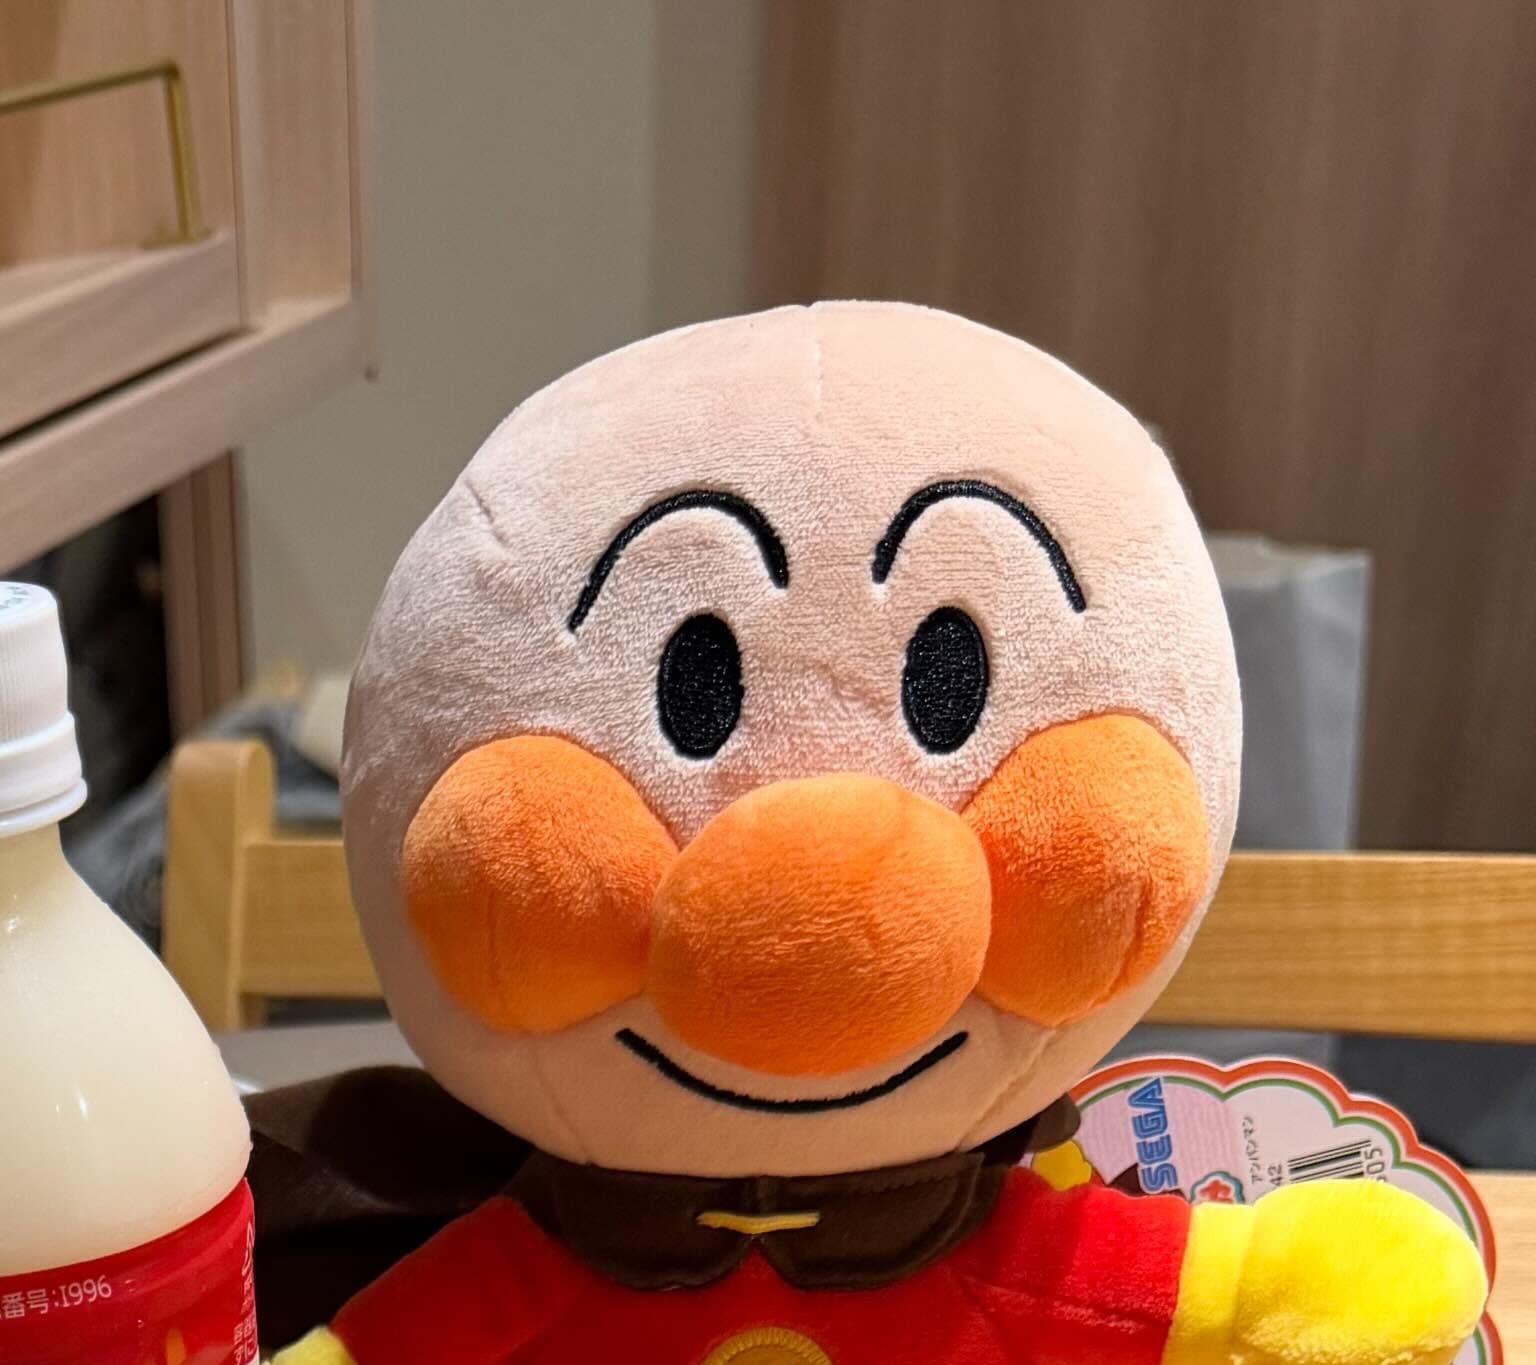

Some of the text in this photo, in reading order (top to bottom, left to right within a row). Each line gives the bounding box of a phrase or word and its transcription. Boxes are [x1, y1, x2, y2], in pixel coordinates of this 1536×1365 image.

[1128, 1077, 1178, 1192] SEGA
[1241, 1115, 1261, 1184] アンパンマン
